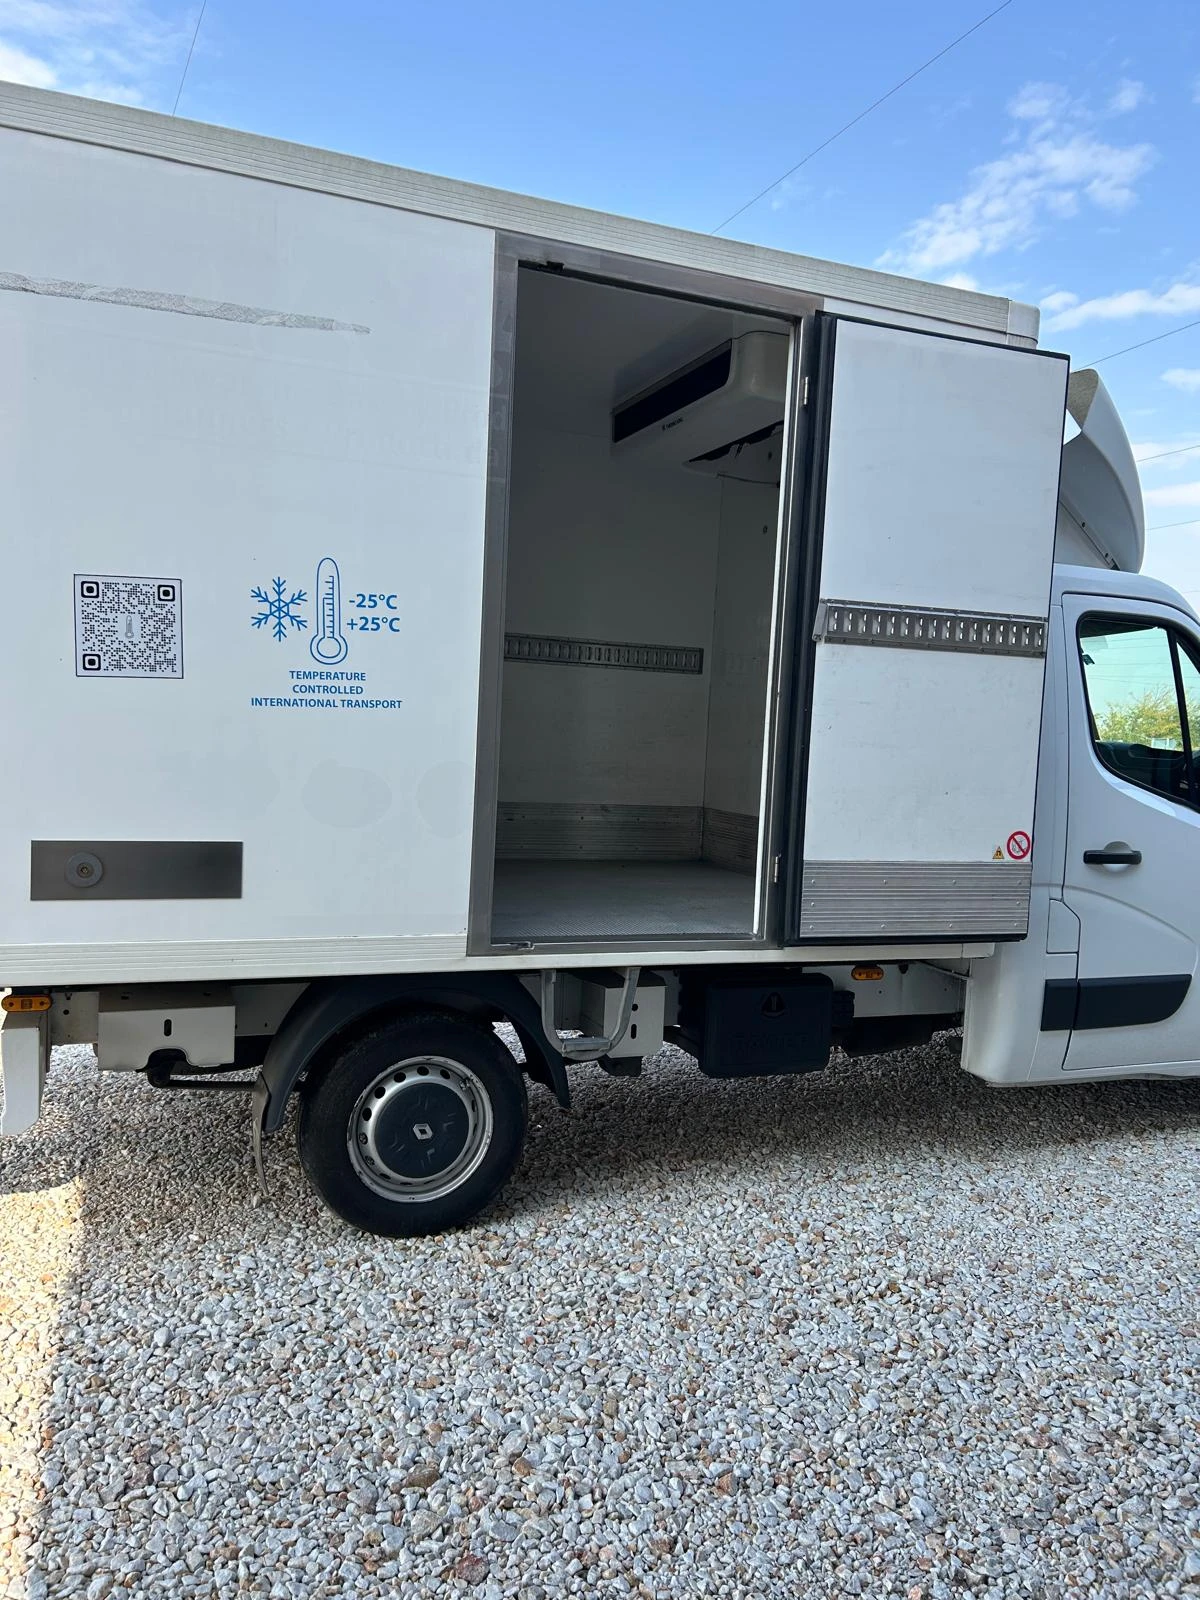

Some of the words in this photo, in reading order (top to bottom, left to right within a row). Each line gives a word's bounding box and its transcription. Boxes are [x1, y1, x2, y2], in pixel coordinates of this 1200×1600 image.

[349, 593, 397, 610] -25°C
[347, 616, 400, 633] +25°C
[289, 670, 366, 681] TEMPERATURE
[292, 684, 364, 695] CONTROLLED
[251, 697, 338, 708] INTERNATIONAL
[341, 699, 402, 709] TRANSPORT
